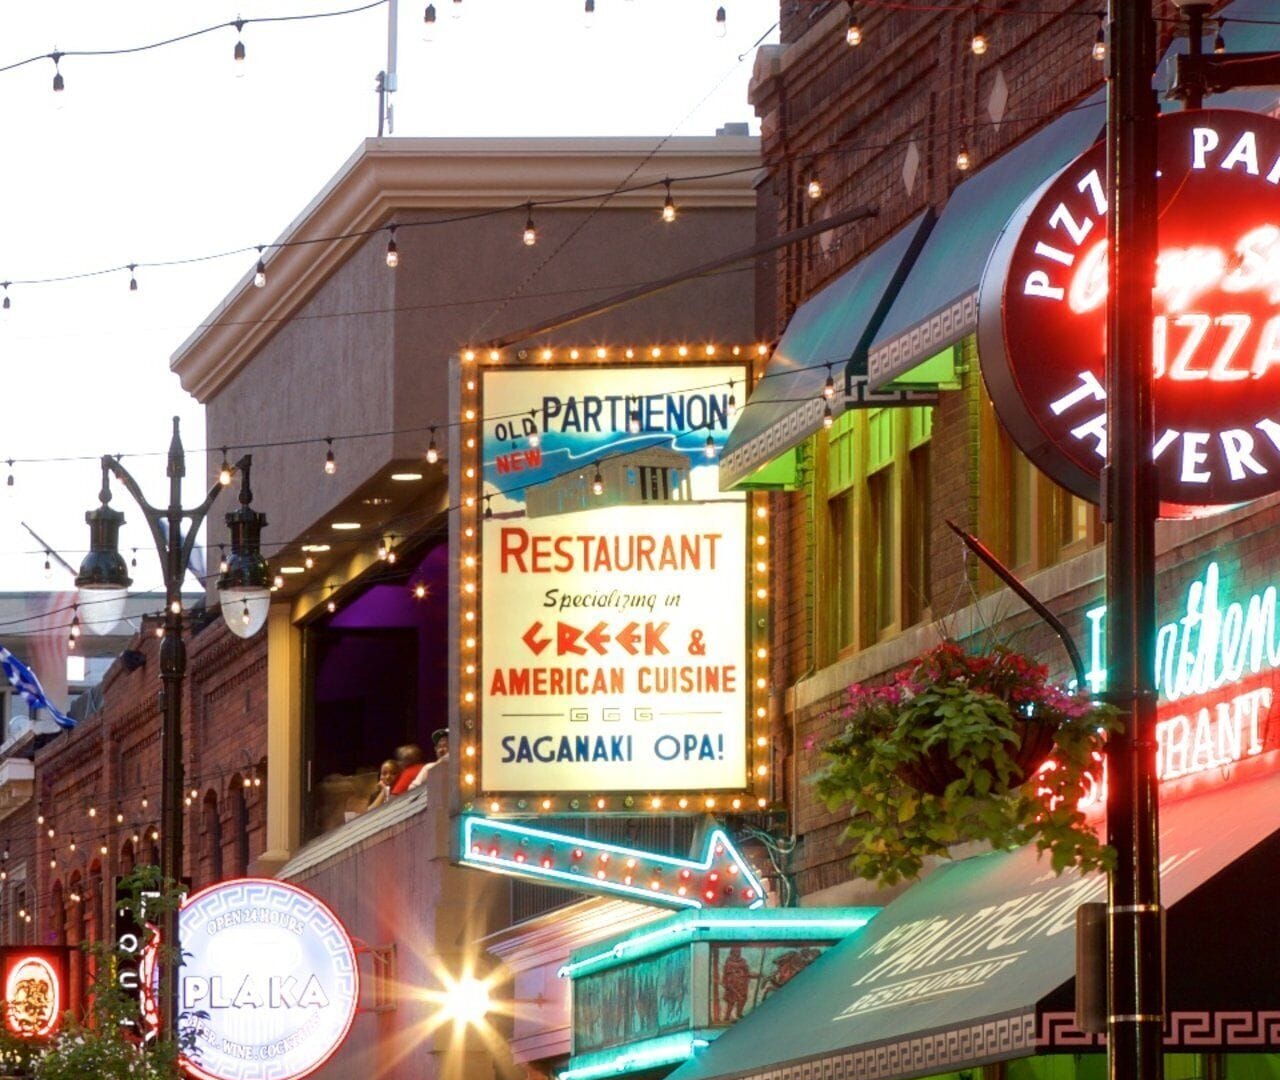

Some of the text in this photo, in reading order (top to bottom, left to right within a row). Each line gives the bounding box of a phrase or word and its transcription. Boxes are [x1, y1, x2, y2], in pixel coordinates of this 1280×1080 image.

[1024, 168, 1162, 300] PIZZ
[1193, 127, 1280, 185] PA
[542, 393, 728, 432] PARTHENON
[1050, 370, 1280, 484] TAER
[495, 417, 537, 442] OLD
[496, 449, 543, 475] NEW
[500, 527, 722, 574] RESTAURANT
[543, 588, 681, 611] Specializing in
[521, 620, 707, 657] GREEK &
[490, 665, 737, 697] AMERICAN CUISINE
[501, 733, 725, 764] SAGANAKI OPA!
[207, 907, 306, 936] OPEN 24 HOURS
[183, 974, 330, 1009] PLAKA
[841, 956, 1019, 1015] RESTAURANT
[223, 1038, 253, 1060] WINE
